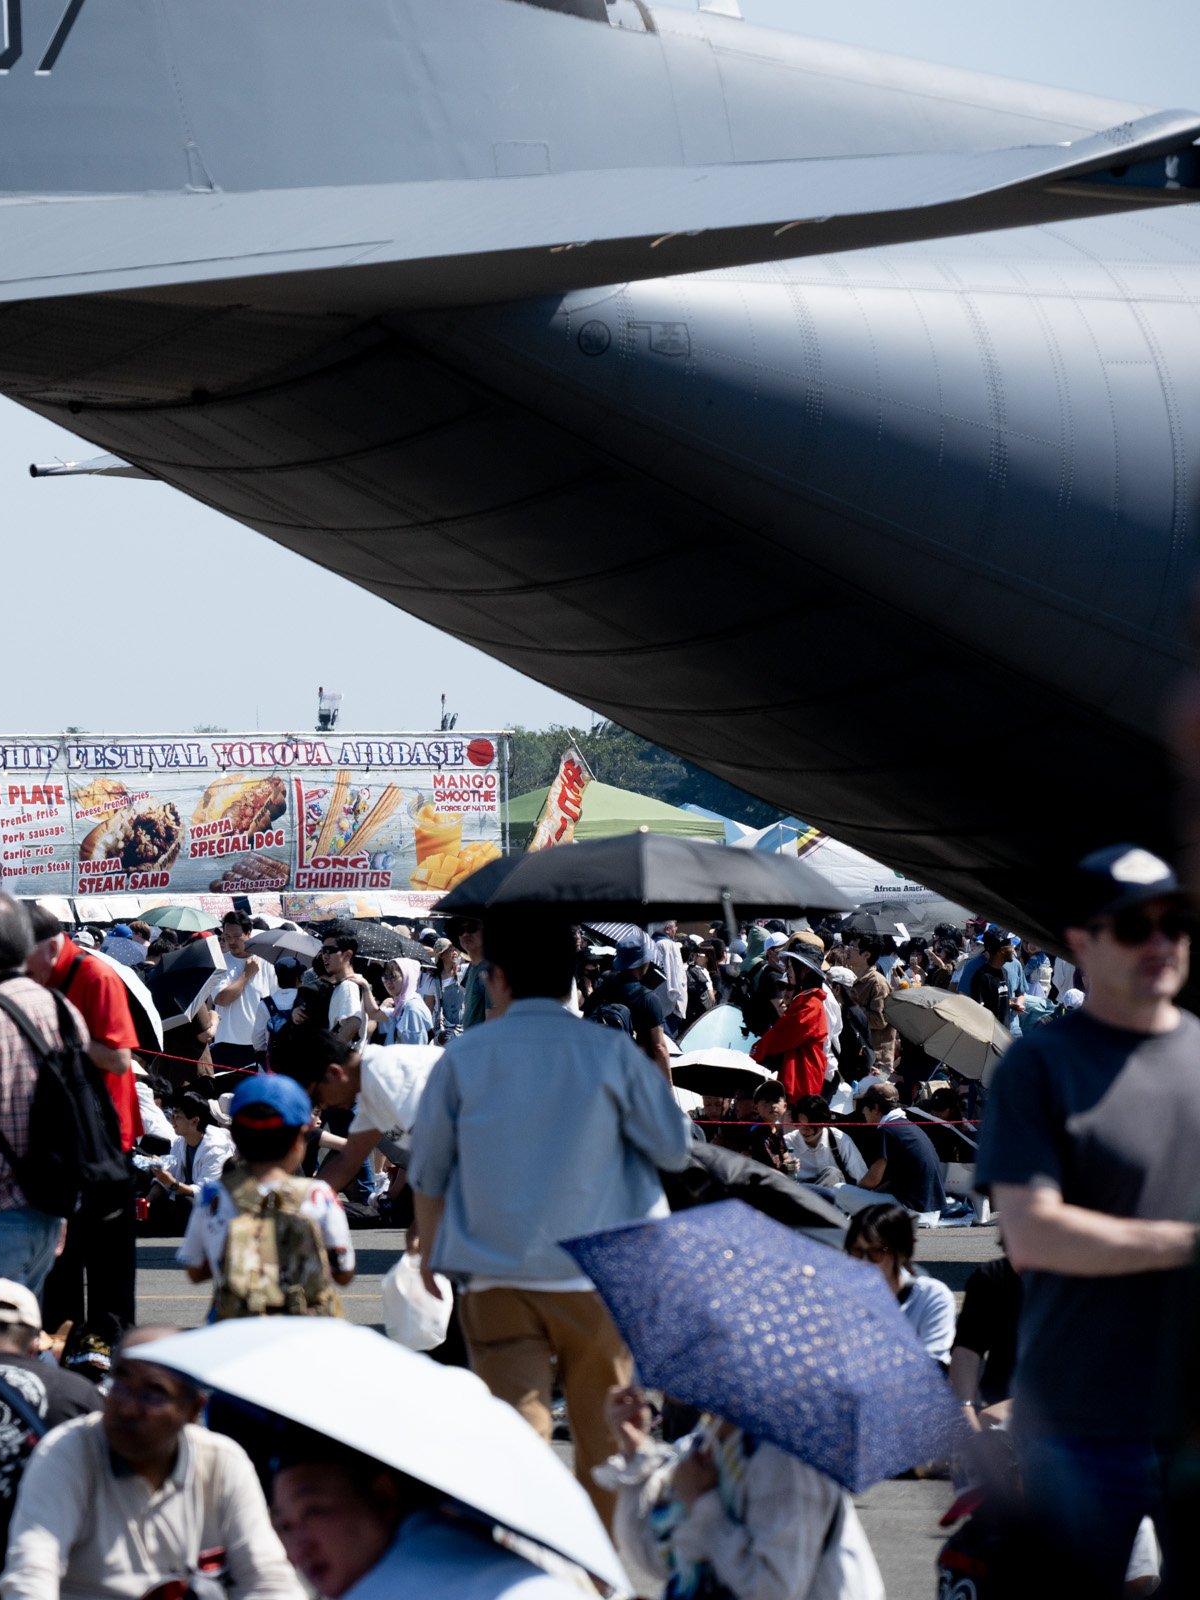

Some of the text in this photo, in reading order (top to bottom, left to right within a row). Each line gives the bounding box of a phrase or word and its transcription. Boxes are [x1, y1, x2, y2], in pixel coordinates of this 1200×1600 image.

[67, 744, 207, 769] FESTIVAL
[212, 742, 332, 766] YOKOTA
[339, 741, 464, 766] AIRBASE
[433, 774, 496, 789] MANGO
[8, 784, 65, 805] PLATE
[434, 790, 496, 802] SMOOTHIE
[75, 791, 150, 819] Cheese french fries
[472, 804, 496, 812] NATURE
[1, 807, 59, 828] French fries
[3, 825, 65, 845] Pork sausage
[189, 819, 232, 840] YOKOTA
[3, 845, 55, 861] Garlic rice
[189, 835, 250, 859] SPECIAL
[254, 830, 285, 850] DOG
[3, 860, 71, 878] Chuck eye Steak
[78, 859, 121, 875] YOKOTA
[78, 871, 170, 894] STEAK SAND
[223, 877, 286, 891] Pork sausage
[295, 870, 393, 889] CHURRITOS
